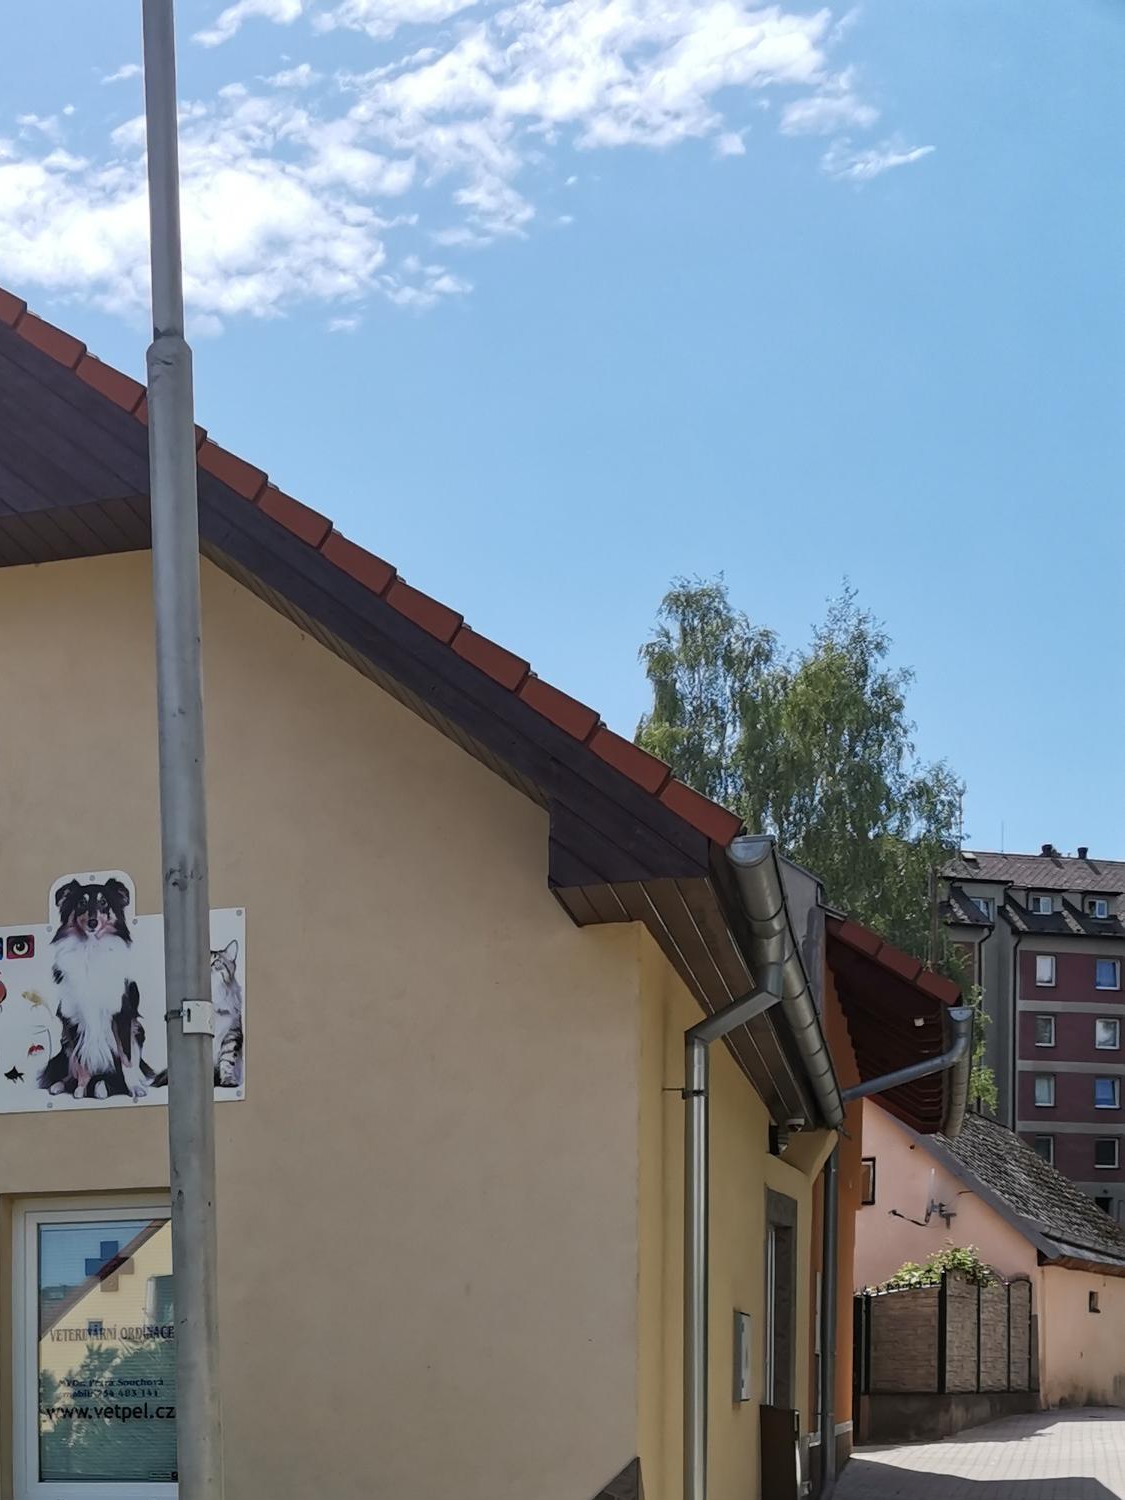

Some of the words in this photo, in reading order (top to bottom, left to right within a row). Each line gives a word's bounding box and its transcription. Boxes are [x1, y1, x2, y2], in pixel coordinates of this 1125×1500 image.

[50, 1324, 116, 1342] VETERINÁRNÍ
[120, 1325, 174, 1340] ORDINACE
[47, 1402, 176, 1422] www.vetpel.cz
